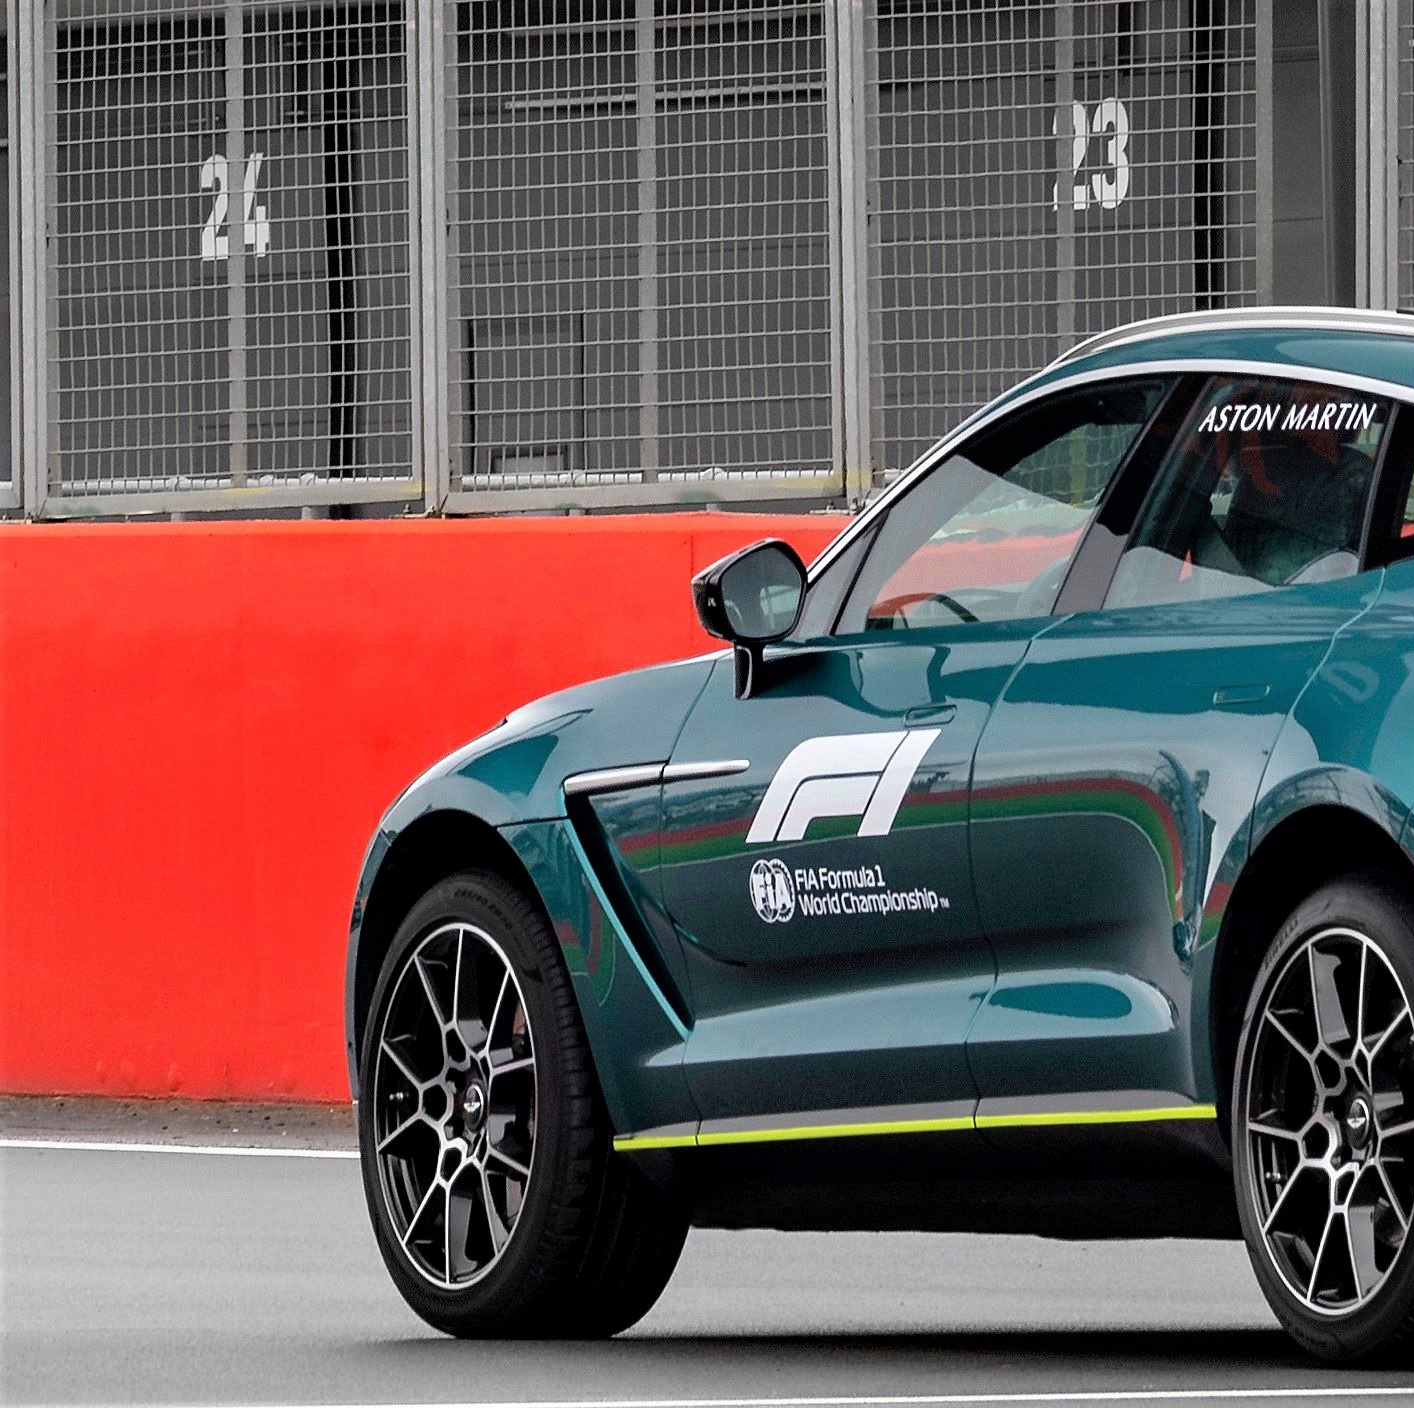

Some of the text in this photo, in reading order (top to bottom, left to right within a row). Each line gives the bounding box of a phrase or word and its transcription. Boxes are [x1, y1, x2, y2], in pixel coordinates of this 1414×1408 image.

[1052, 97, 1129, 212] 23
[200, 153, 270, 261] 24
[1199, 402, 1377, 432] ASTON MARTIN
[795, 864, 886, 891] FIA Formula 1
[798, 893, 841, 917] World
[841, 887, 938, 916] Championship
